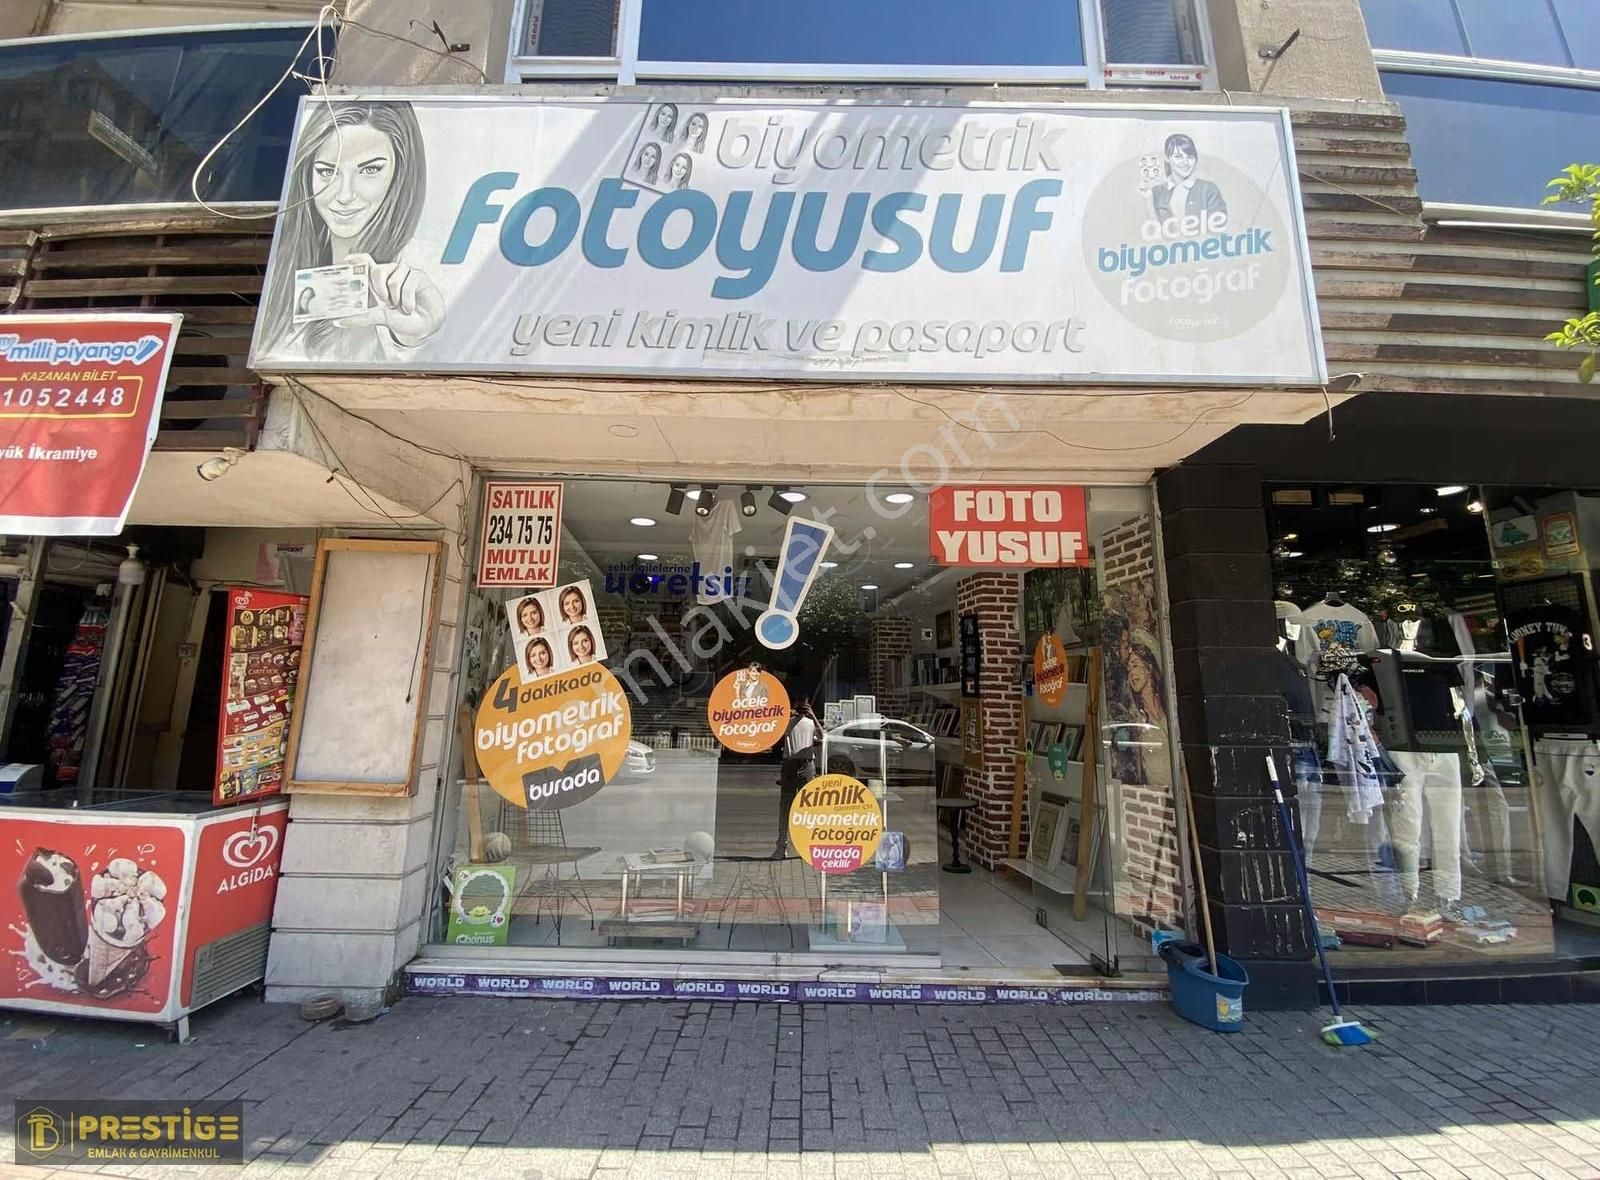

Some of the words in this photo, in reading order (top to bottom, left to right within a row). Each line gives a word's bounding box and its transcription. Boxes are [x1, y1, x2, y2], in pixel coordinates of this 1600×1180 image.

[717, 115, 1064, 186] biyometrik
[440, 171, 1064, 300] fotoyusuf
[1141, 208, 1228, 241] acele
[1098, 227, 1273, 277] biyometrik
[1120, 263, 1260, 307] fotoğraf
[510, 307, 624, 357] yeni
[626, 309, 778, 352] kimlik
[786, 317, 847, 352] ve
[852, 315, 1087, 359] pasaport
[20, 371, 81, 381] KAZANAN
[82, 369, 118, 381] BİLET
[492, 490, 556, 509] SATILIK
[953, 490, 1063, 523] FOTO
[488, 515, 513, 544] 234
[517, 515, 533, 544] 75
[537, 515, 553, 544] 75
[487, 549, 551, 565] MUTLU
[936, 530, 1083, 564] YUSUF
[485, 567, 549, 581] EMLAK
[493, 677, 518, 713] 4
[520, 670, 603, 704] dakikada
[732, 696, 768, 709] acele
[477, 691, 623, 750] biyometrik
[713, 705, 784, 724] biyometrik
[515, 712, 624, 764] fotoğraf
[719, 719, 777, 737] fotoğraf
[529, 767, 600, 801] burada
[822, 777, 842, 789] yeni
[799, 785, 866, 808] kimlik
[792, 811, 879, 830] biyometrik
[811, 828, 878, 844] fotoğraf
[812, 846, 861, 859] burada
[414, 977, 465, 988] WORLD
[478, 978, 529, 989] WORLD
[542, 979, 593, 990] WORLD
[609, 981, 660, 991] WORLD
[674, 981, 725, 993] WORLD
[737, 983, 789, 995] WORLD
[805, 987, 856, 998] WORLD
[869, 988, 921, 1000] WORLD
[934, 990, 986, 1001] WORLD
[996, 989, 1048, 1000] WORLD
[1060, 990, 1113, 1001] WORLD
